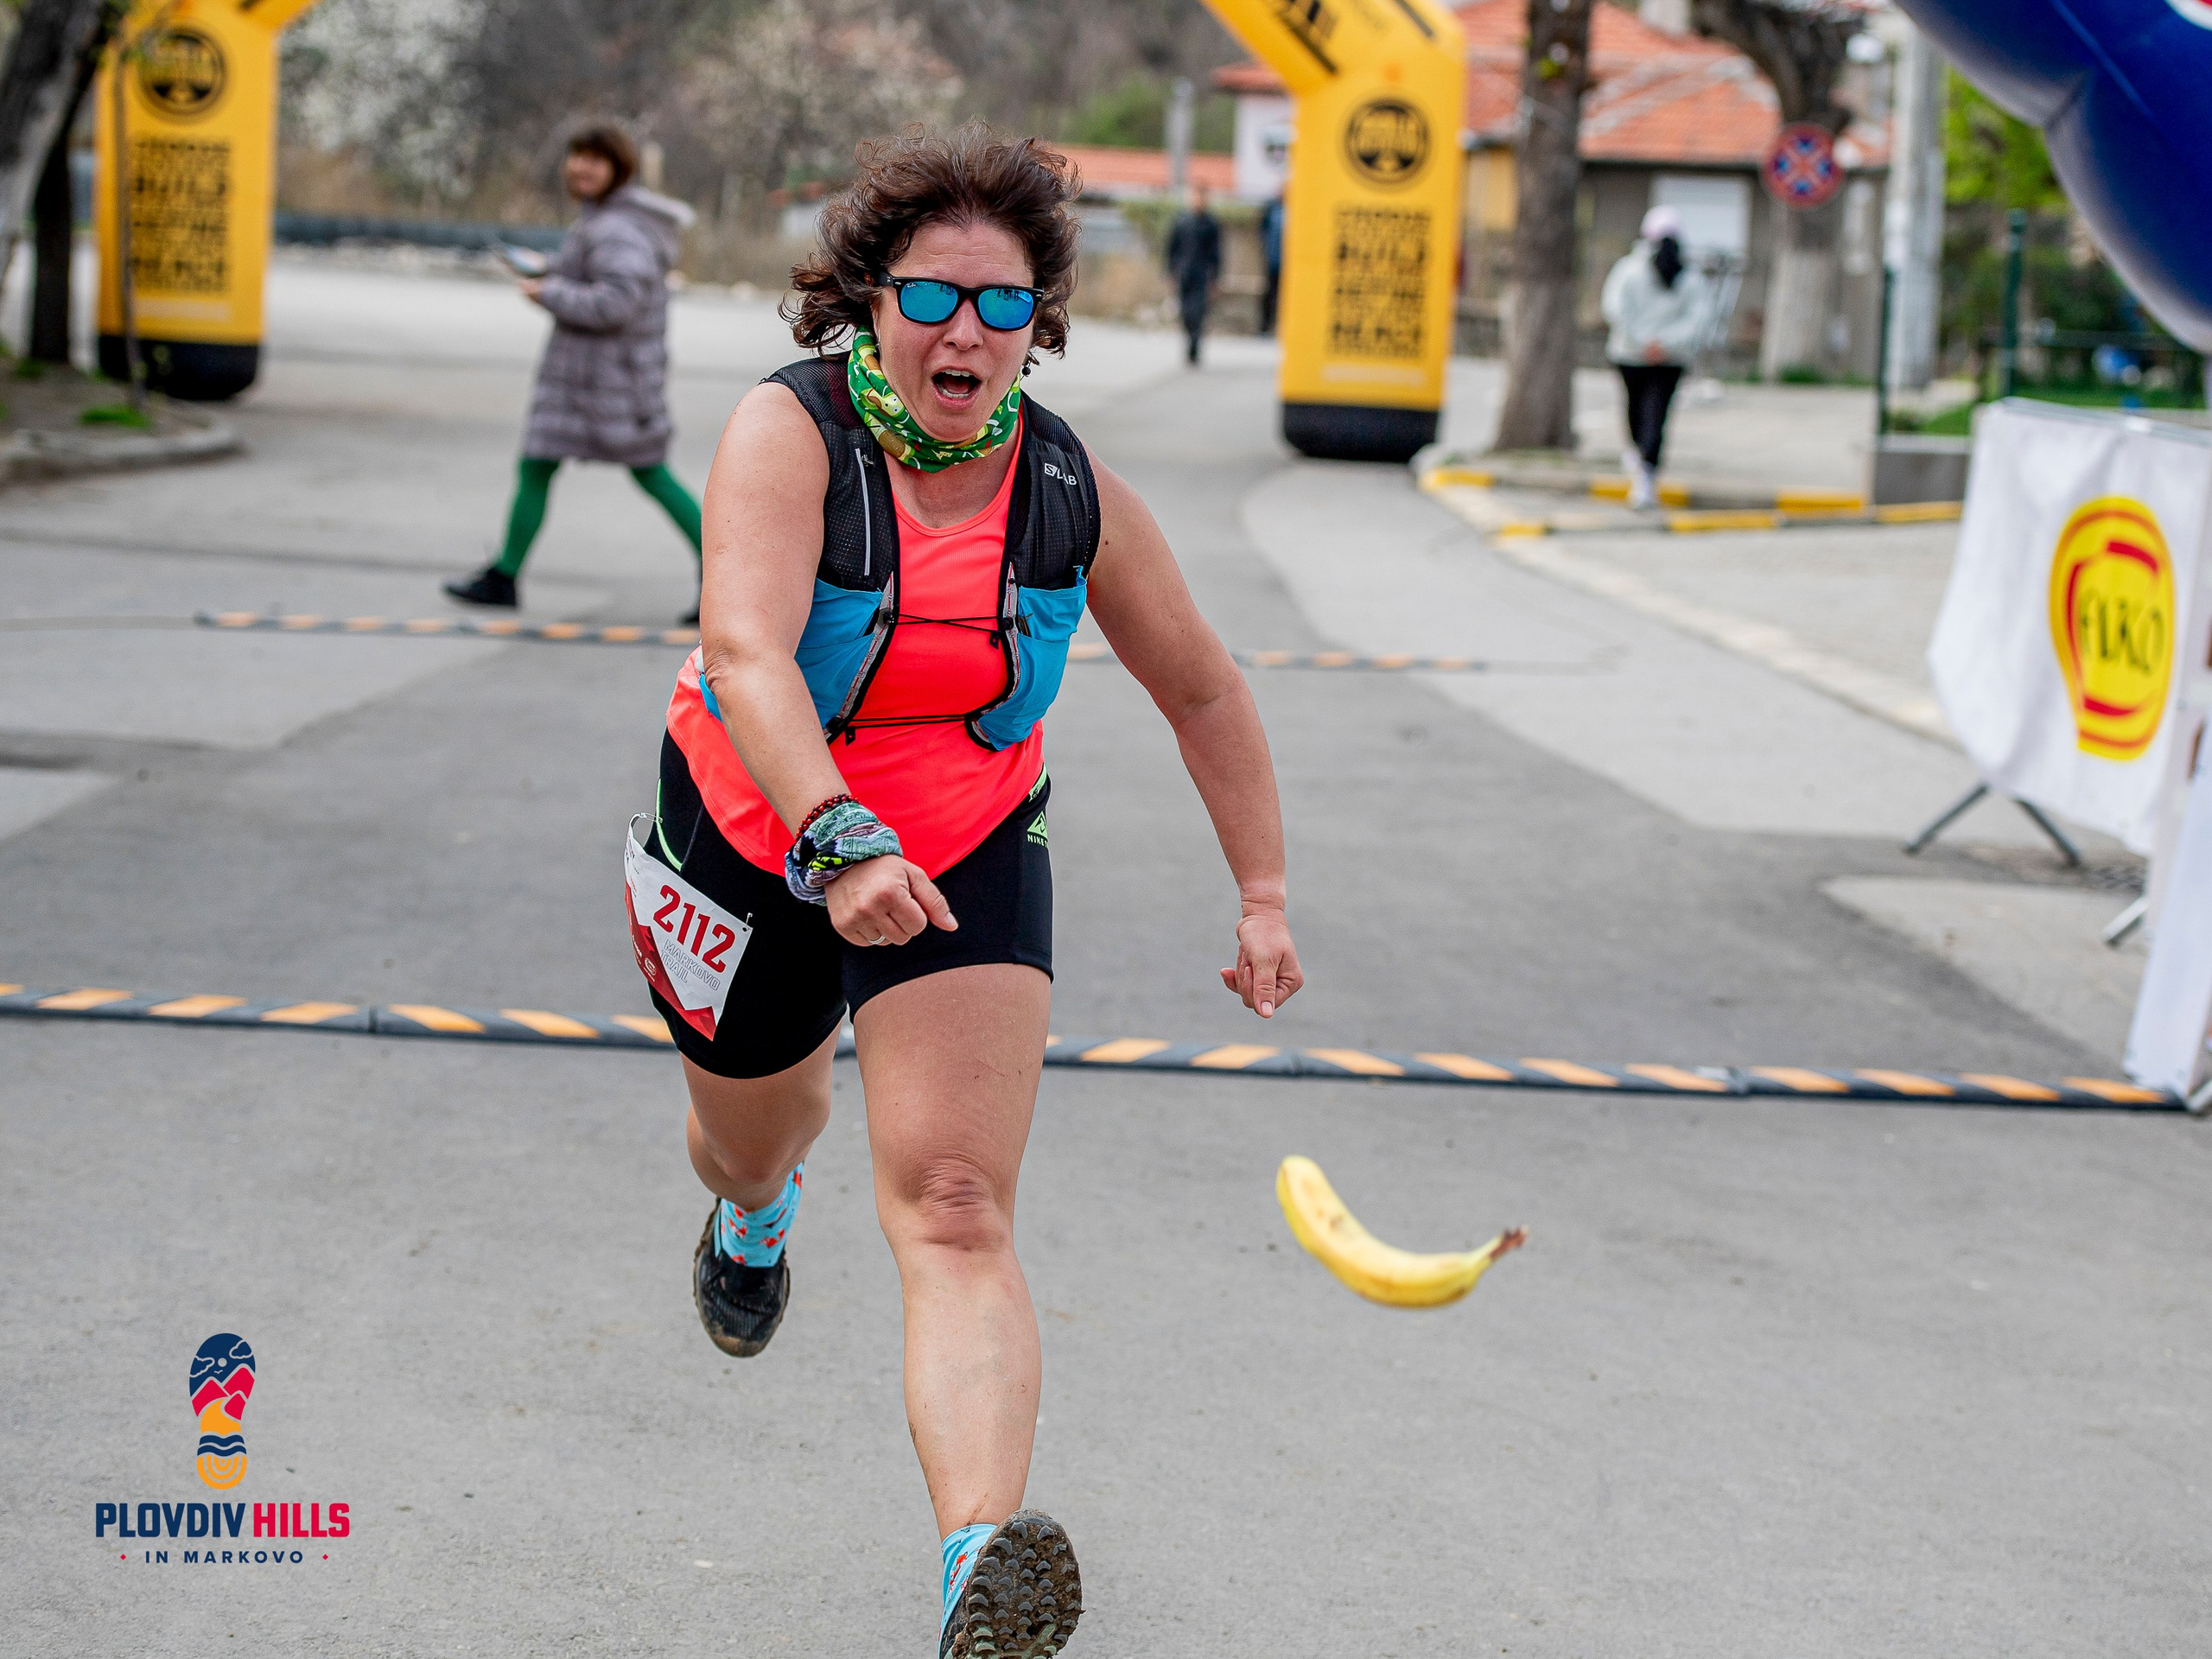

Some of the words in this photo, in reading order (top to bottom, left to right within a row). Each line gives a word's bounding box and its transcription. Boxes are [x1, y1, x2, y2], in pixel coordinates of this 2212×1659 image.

[653, 885, 735, 973] 2112
[661, 949, 688, 983] TRAIL
[664, 938, 721, 991] MARKOVO
